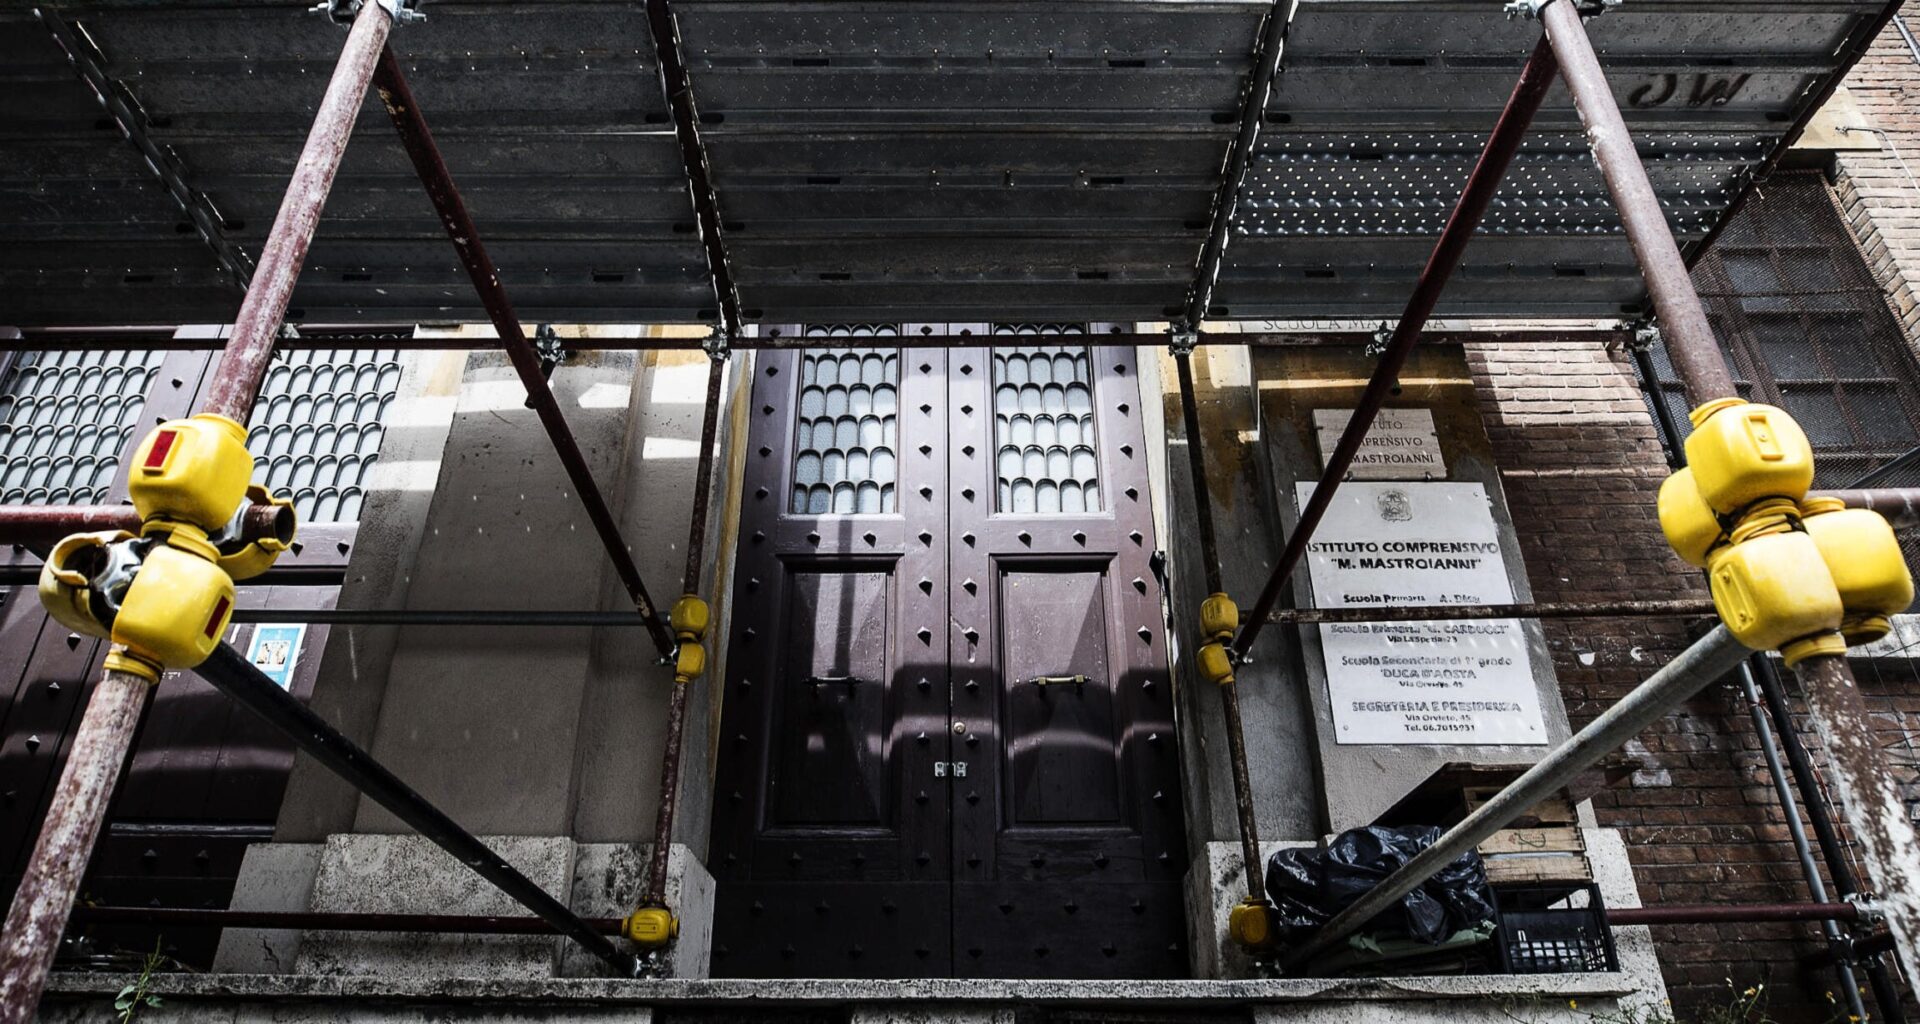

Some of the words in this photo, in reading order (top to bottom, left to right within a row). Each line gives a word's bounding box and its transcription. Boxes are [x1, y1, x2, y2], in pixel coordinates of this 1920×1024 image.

[1307, 542, 1378, 553] ISTITUTO
[1382, 542, 1499, 553] COMPRENSIVO
[1360, 558, 1481, 570] MASTROIANNI"
[1343, 594, 1381, 603] Scuola
[1383, 594, 1425, 603] Primaria
[1331, 624, 1370, 634] Scuola
[1387, 635, 1402, 643] Via
[1342, 656, 1380, 666] Scuola
[1381, 656, 1447, 665] Secondaria
[1449, 656, 1461, 665] di
[1478, 656, 1512, 668] grado
[1352, 701, 1429, 712] SEGRETERIA
[1431, 701, 1440, 712] E
[1442, 701, 1521, 713] PRESIDENZA
[1404, 724, 1422, 732] Tel.
